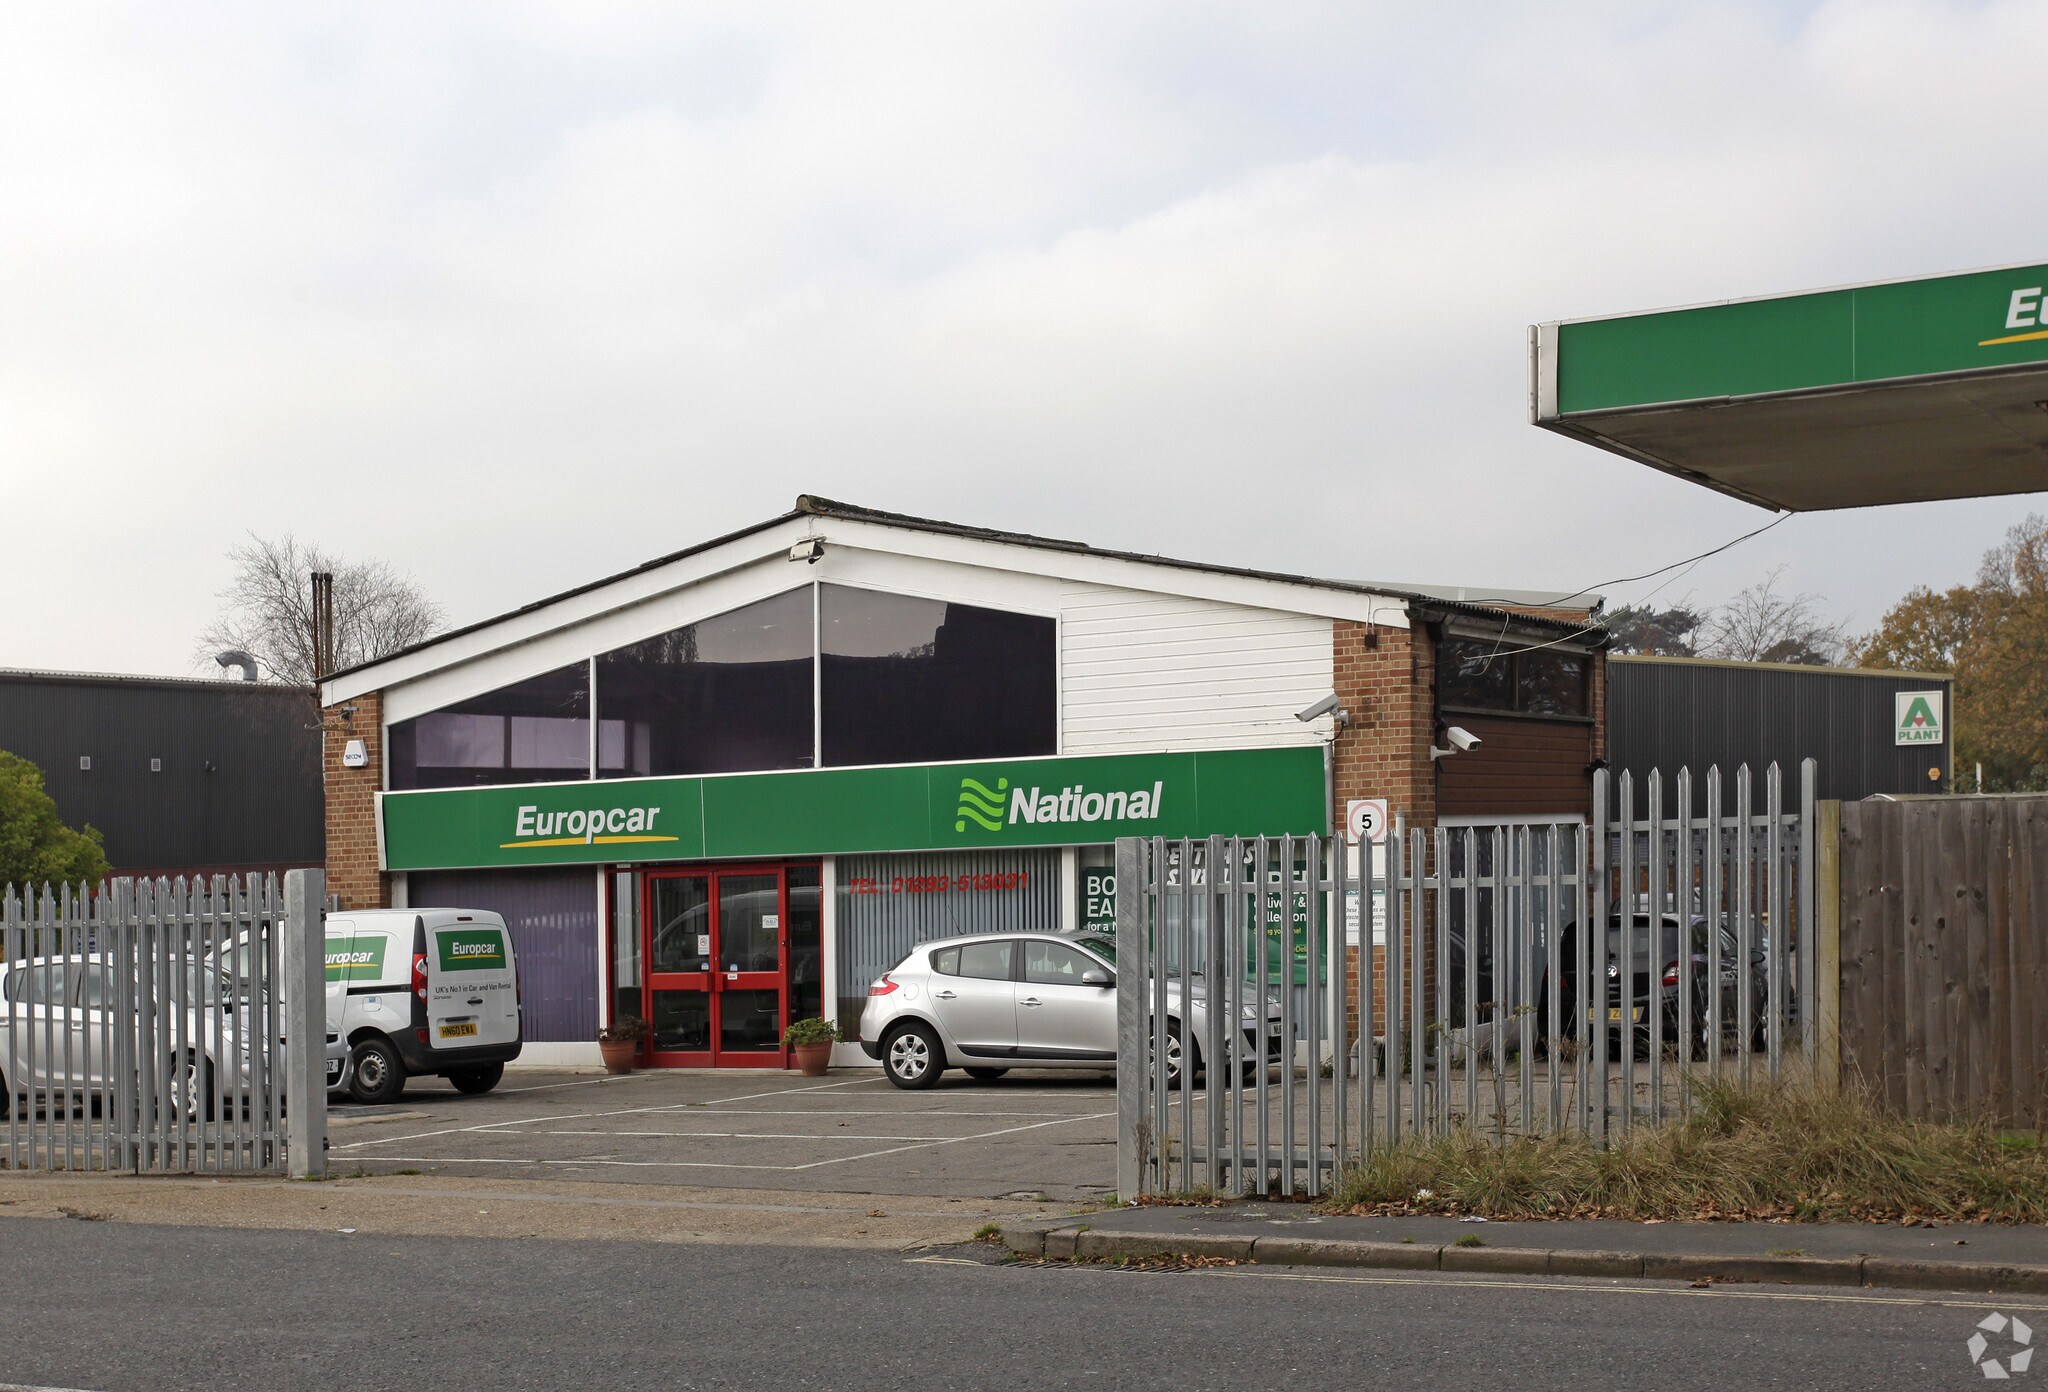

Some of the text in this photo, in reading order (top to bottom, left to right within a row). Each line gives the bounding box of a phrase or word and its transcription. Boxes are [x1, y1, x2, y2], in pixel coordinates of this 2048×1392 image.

[1901, 697, 1938, 728] A
[1898, 730, 1940, 741] PLANT
[1008, 781, 1163, 825] National
[515, 805, 660, 844] Europcar
[1361, 814, 1373, 829] 5
[849, 872, 1028, 894] TEL: 01293-513031
[1087, 897, 1117, 918] EA
[1298, 896, 1306, 908] &
[1087, 921, 1102, 932] for
[1103, 923, 1109, 932] a
[452, 942, 496, 958] Europcar
[325, 951, 374, 966] uropcar
[468, 984, 478, 992] Car
[479, 983, 489, 991] and
